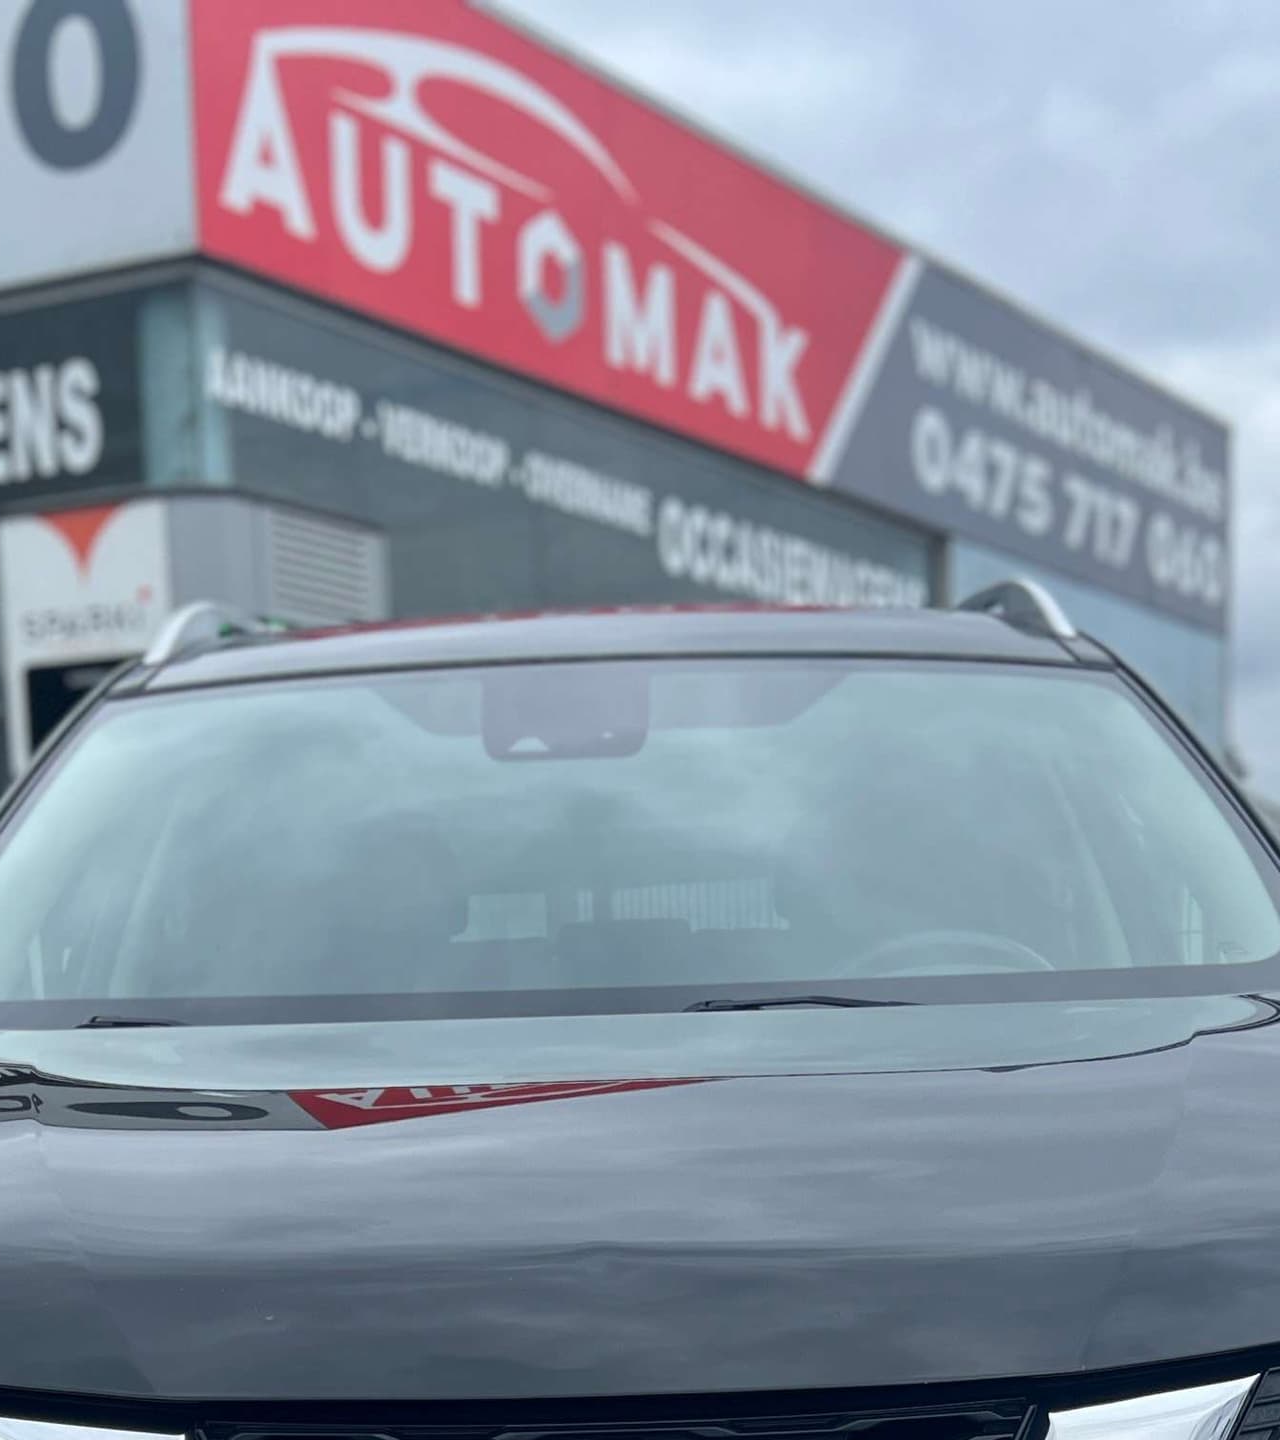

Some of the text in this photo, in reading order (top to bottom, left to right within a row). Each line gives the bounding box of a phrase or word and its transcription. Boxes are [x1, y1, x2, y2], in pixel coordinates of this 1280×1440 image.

[219, 28, 814, 443] AUTOMAK
[910, 402, 1057, 538] 0475
[1063, 472, 1141, 570] 717
